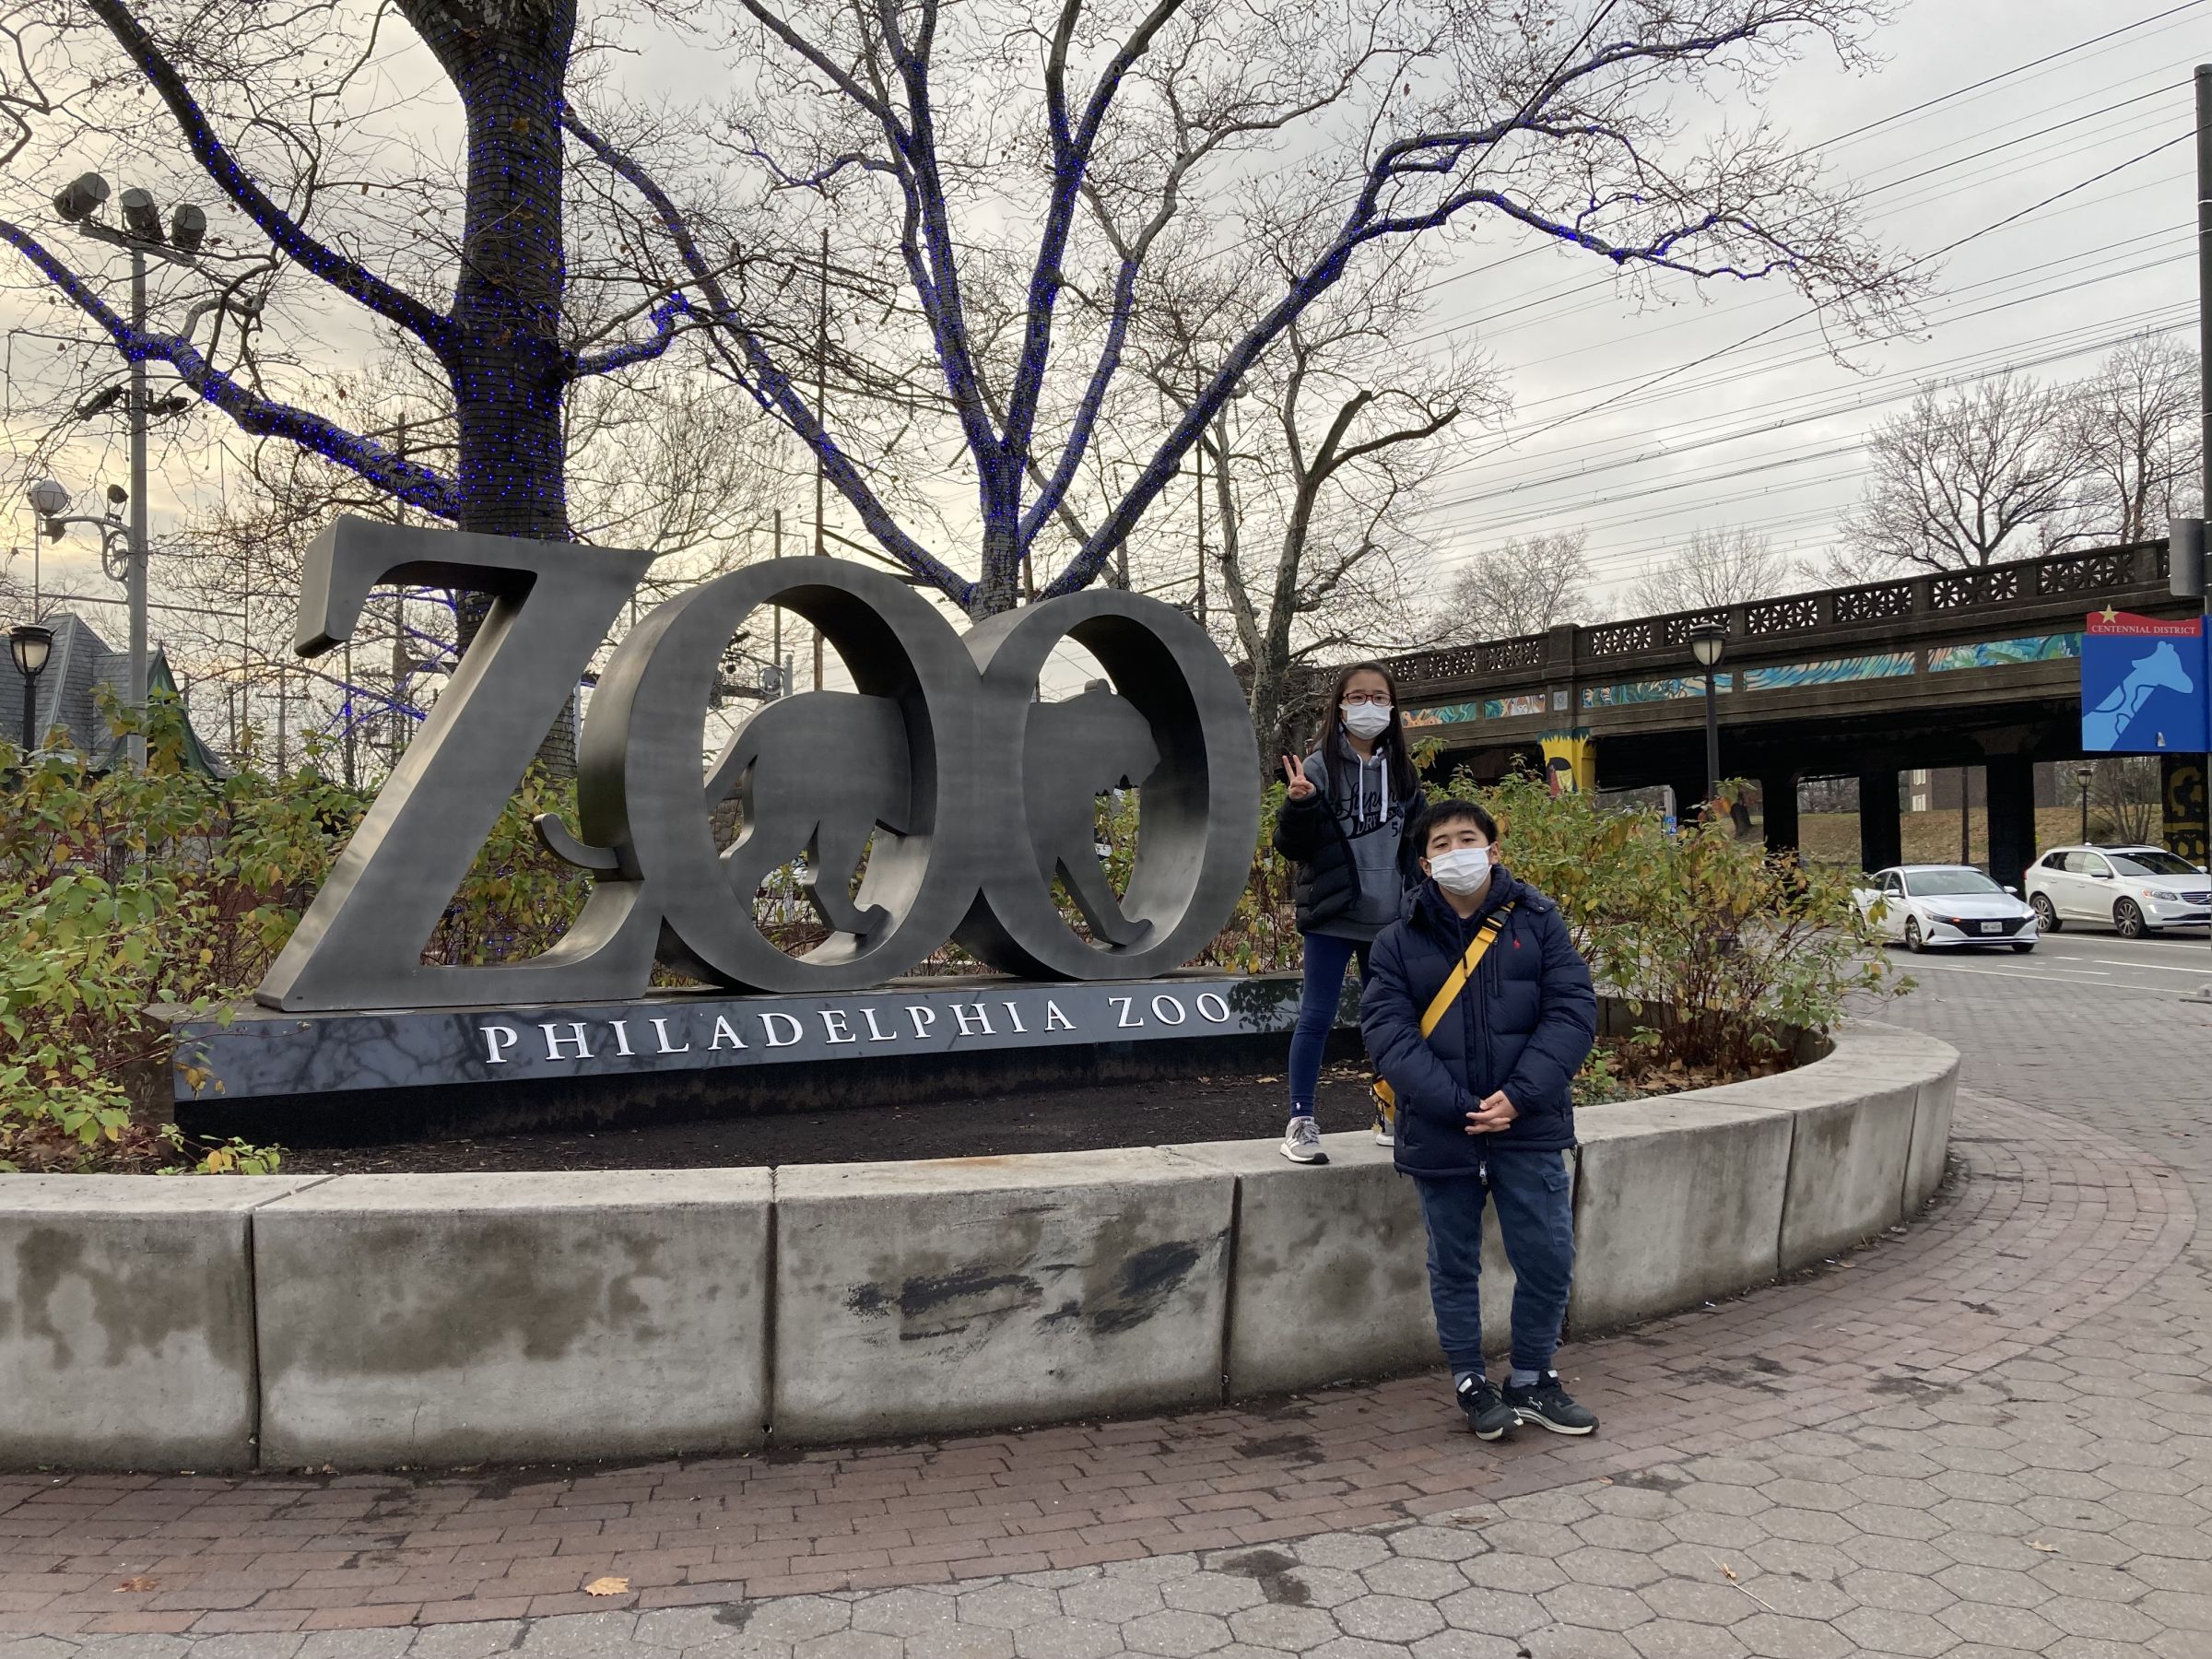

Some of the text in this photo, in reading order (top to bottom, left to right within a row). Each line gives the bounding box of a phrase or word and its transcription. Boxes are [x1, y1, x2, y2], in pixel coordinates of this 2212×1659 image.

[2091, 625, 2196, 634] CENTENNIAL DISTRICT
[254, 513, 1261, 1012] ZOO
[1356, 814, 1379, 834] DRY
[480, 993, 1230, 1064] PHILADELPHIA ZOO
